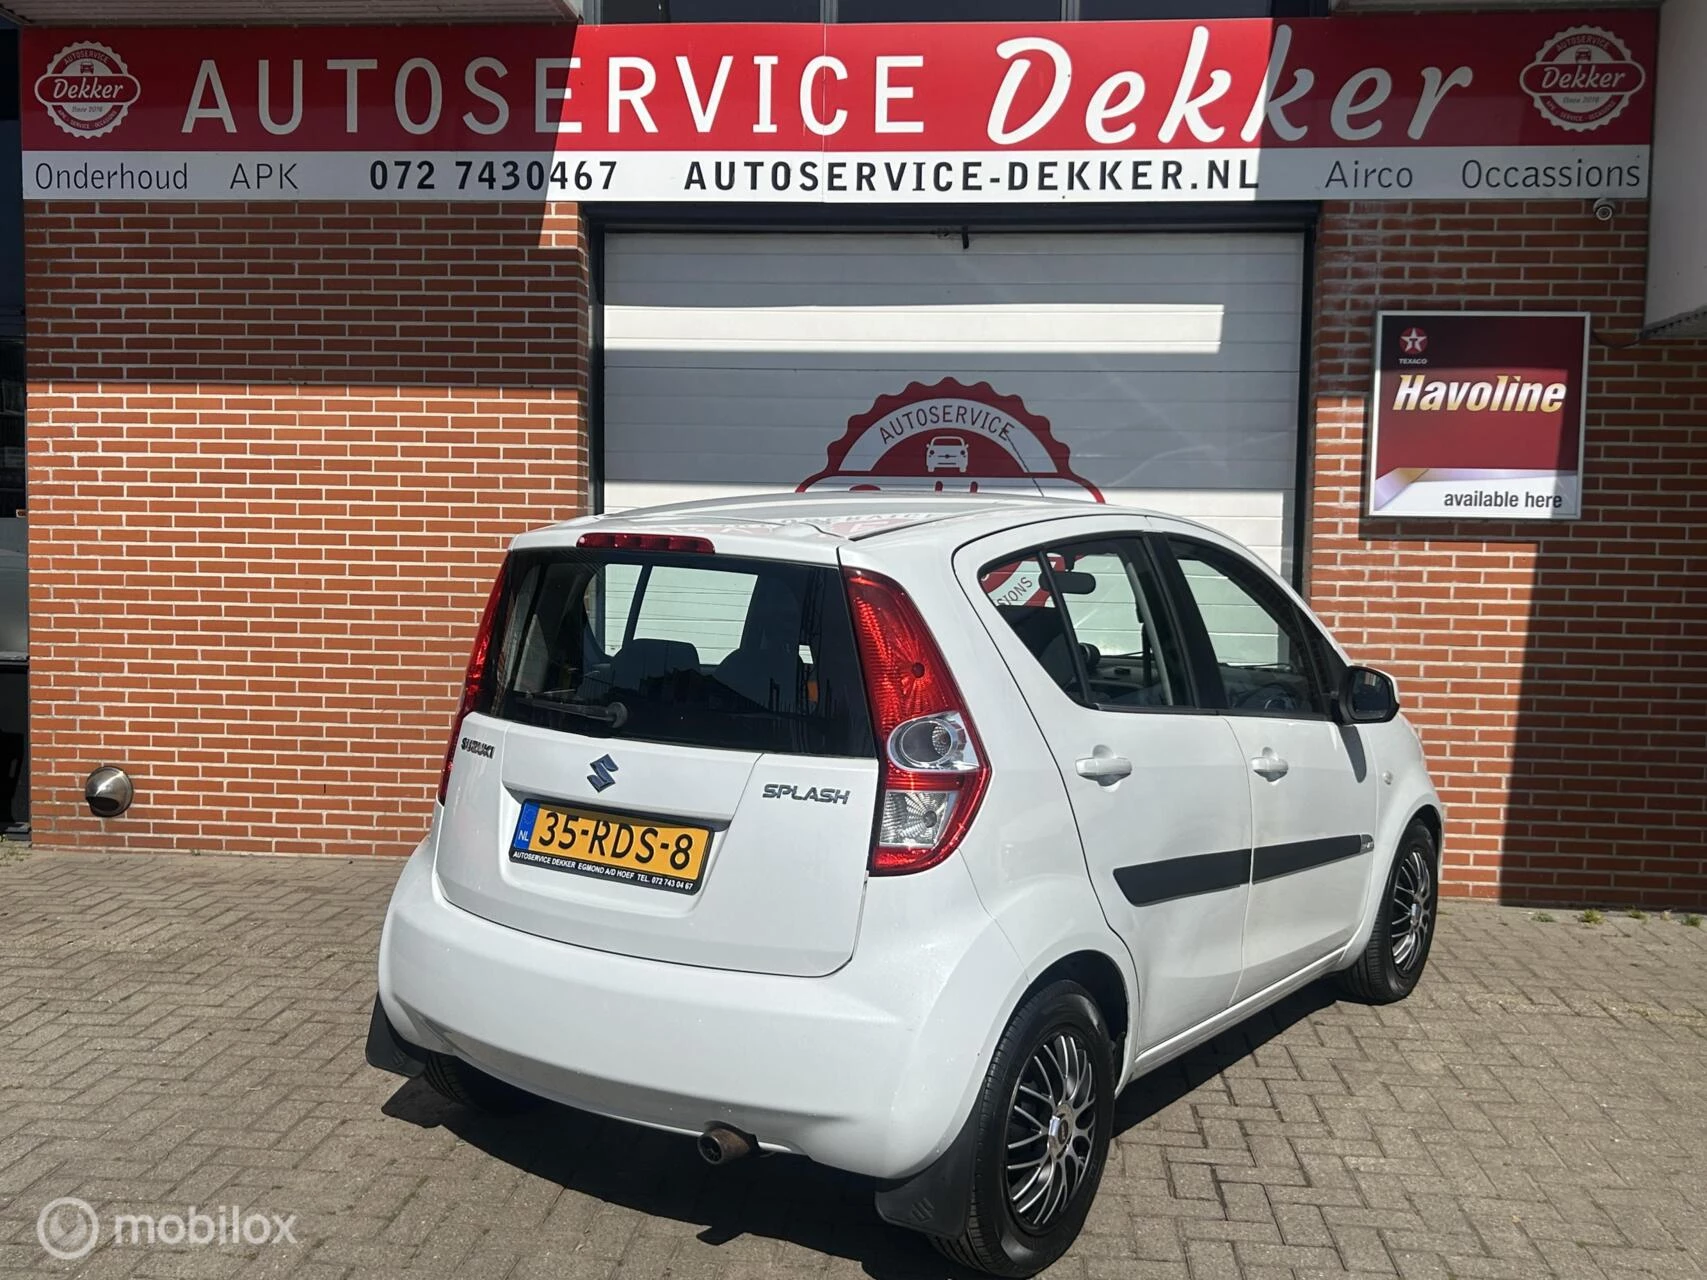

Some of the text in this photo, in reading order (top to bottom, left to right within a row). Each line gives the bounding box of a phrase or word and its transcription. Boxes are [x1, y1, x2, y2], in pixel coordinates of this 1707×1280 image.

[53, 76, 124, 99] Dekker
[181, 25, 1473, 145] AUTOSERVICE Dekker
[1541, 64, 1626, 89] Dekker
[35, 161, 189, 191] Onderhoud
[230, 163, 298, 190] APK
[369, 161, 617, 190] 072 7430467
[684, 161, 1259, 191] AUTOSERVICE-DEKKER.NL
[1325, 160, 1414, 189] Airco
[1462, 159, 1641, 189] Occassions
[1392, 374, 1568, 413] Havoline
[879, 404, 1016, 445] AUTOSERVICE
[1444, 491, 1563, 508] available here
[461, 737, 495, 759] SUZUKI
[762, 783, 851, 804] SPLASH
[518, 830, 529, 842] NL
[538, 811, 693, 870] 35-RDS-8
[513, 851, 551, 864] AUTOSERVICE
[551, 857, 576, 869] DEKKER
[578, 863, 605, 874] EGMOND
[605, 868, 616, 876] A/D
[617, 870, 634, 879] HOEF
[637, 874, 650, 882] TEL.
[651, 877, 662, 885] 072
[664, 879, 675, 888] 743
